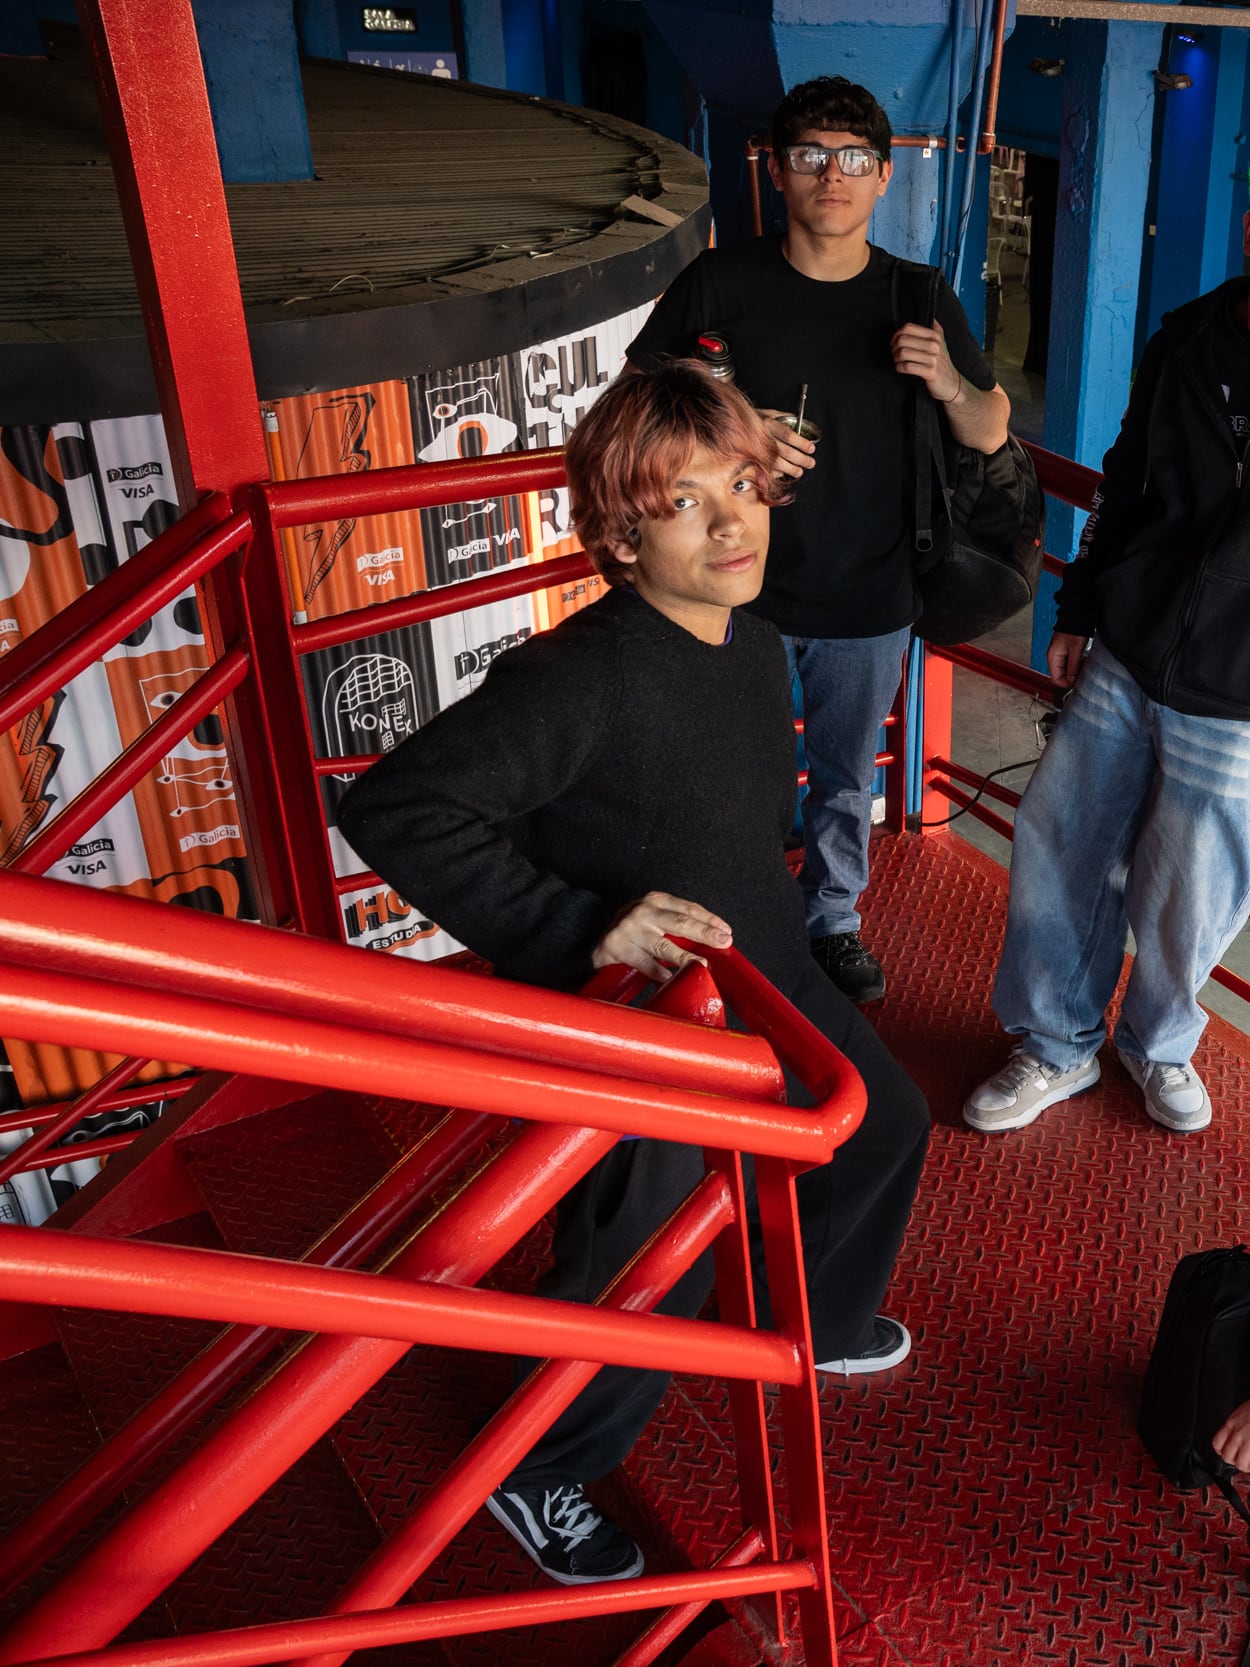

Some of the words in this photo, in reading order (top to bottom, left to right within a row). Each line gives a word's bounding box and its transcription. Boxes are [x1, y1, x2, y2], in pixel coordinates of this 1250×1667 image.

[124, 463, 160, 479] Galicia
[120, 486, 154, 499] VISA
[364, 569, 395, 585] VISA
[349, 711, 414, 737] KONEX
[199, 826, 237, 844] Galicia
[72, 839, 112, 856] Galicia
[66, 860, 107, 876] VISA
